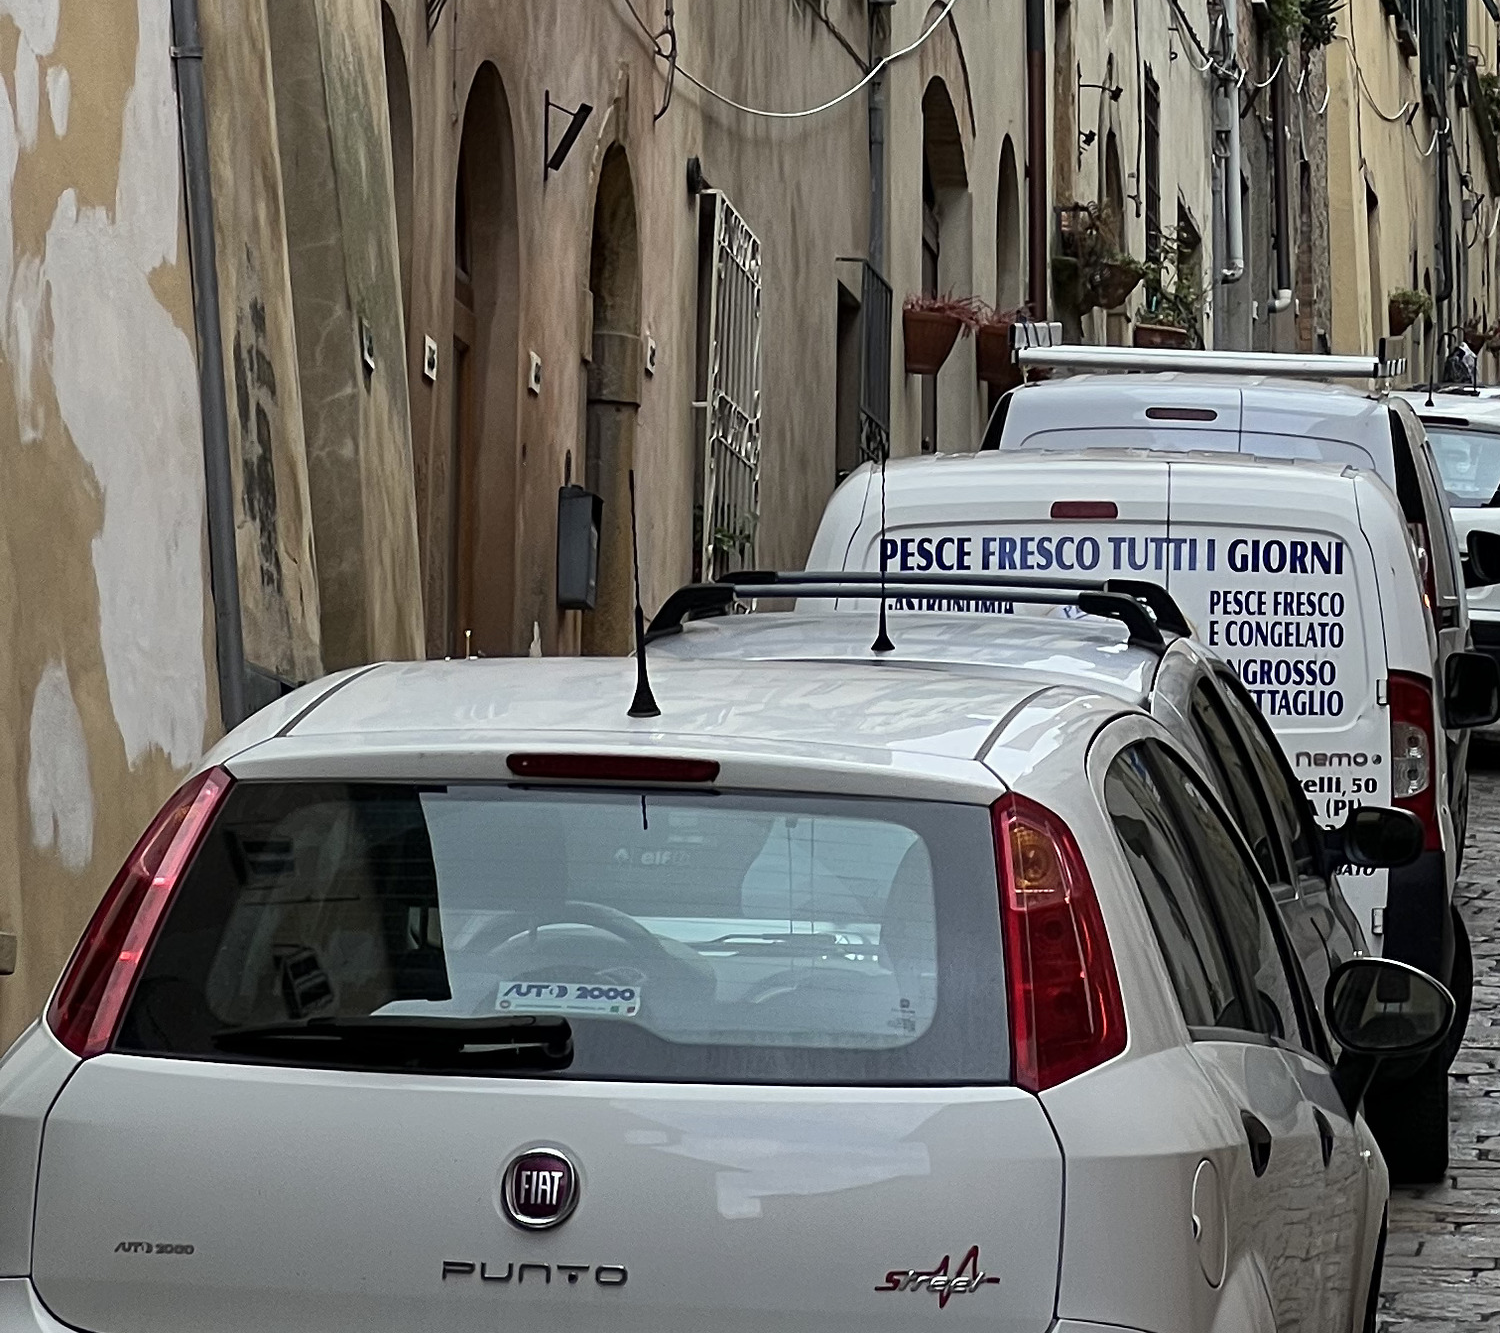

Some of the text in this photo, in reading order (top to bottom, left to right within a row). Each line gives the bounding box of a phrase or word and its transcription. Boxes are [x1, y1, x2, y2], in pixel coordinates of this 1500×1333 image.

[880, 536, 1344, 575] PESCE FRESCO TUTTI I GIORNI
[1209, 590, 1345, 618] PESCE FRESCO
[1208, 620, 1344, 648] E CONGELATO
[1226, 658, 1336, 686] NGROSSO
[1247, 689, 1344, 717] TTAGLIO
[1295, 751, 1368, 768] nemo
[1300, 776, 1378, 797] elli, 50
[503, 983, 636, 1002] AUTO 2000
[519, 1170, 564, 1206] FIAT
[155, 1243, 195, 1255] 2000
[441, 1260, 629, 1286] PUNTO
